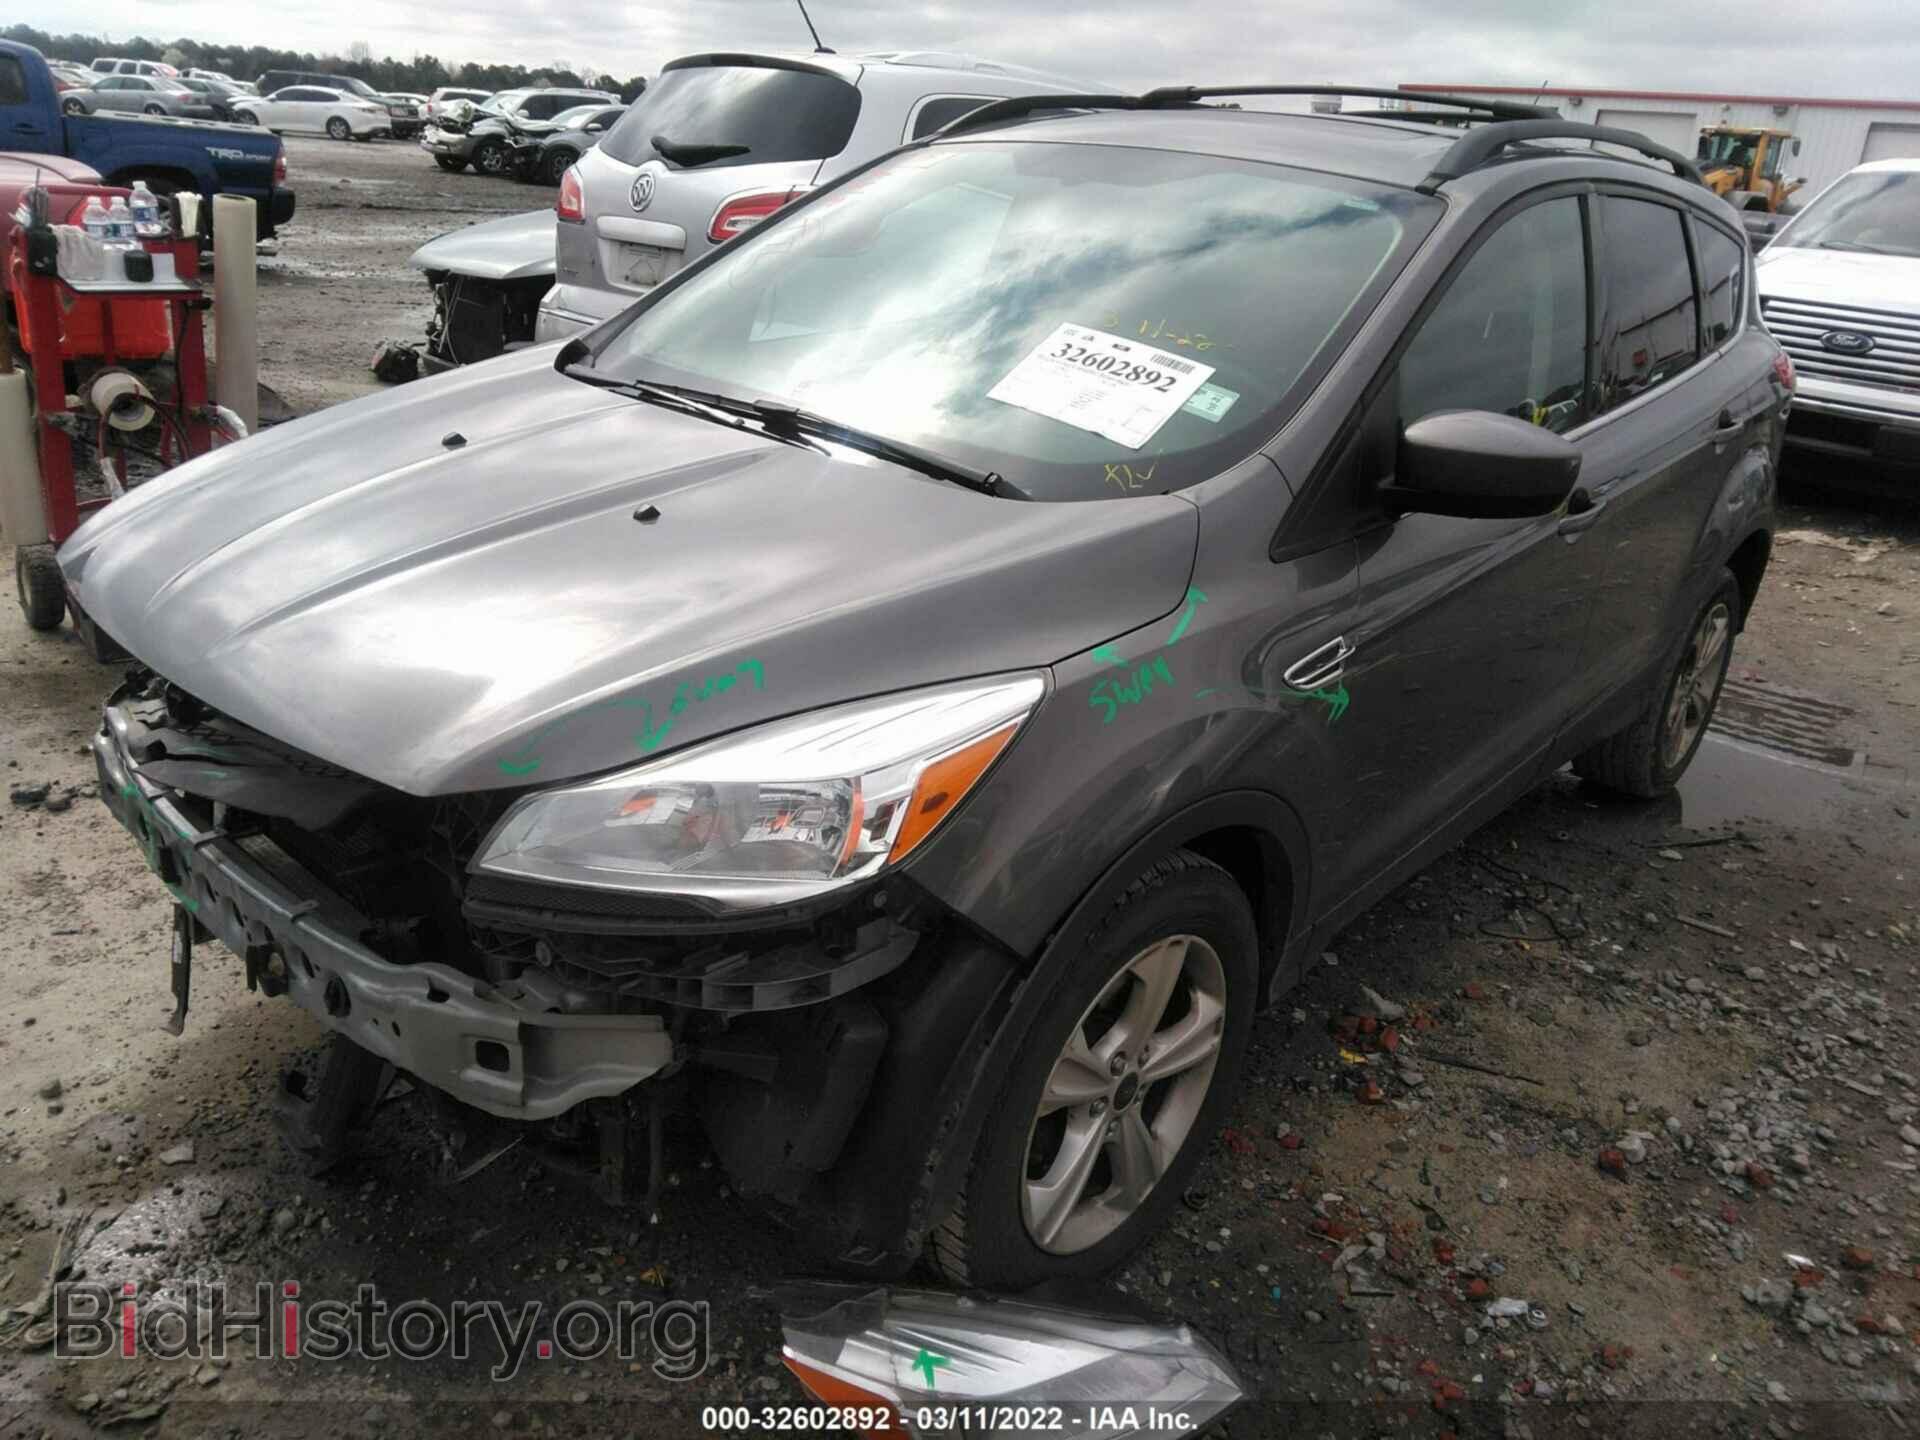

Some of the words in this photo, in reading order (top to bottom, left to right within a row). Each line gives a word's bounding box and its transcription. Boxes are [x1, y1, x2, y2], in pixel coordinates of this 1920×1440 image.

[204, 146, 244, 161] TRD
[1831, 334, 1862, 346] Ford
[1050, 342, 1179, 394] 32602892
